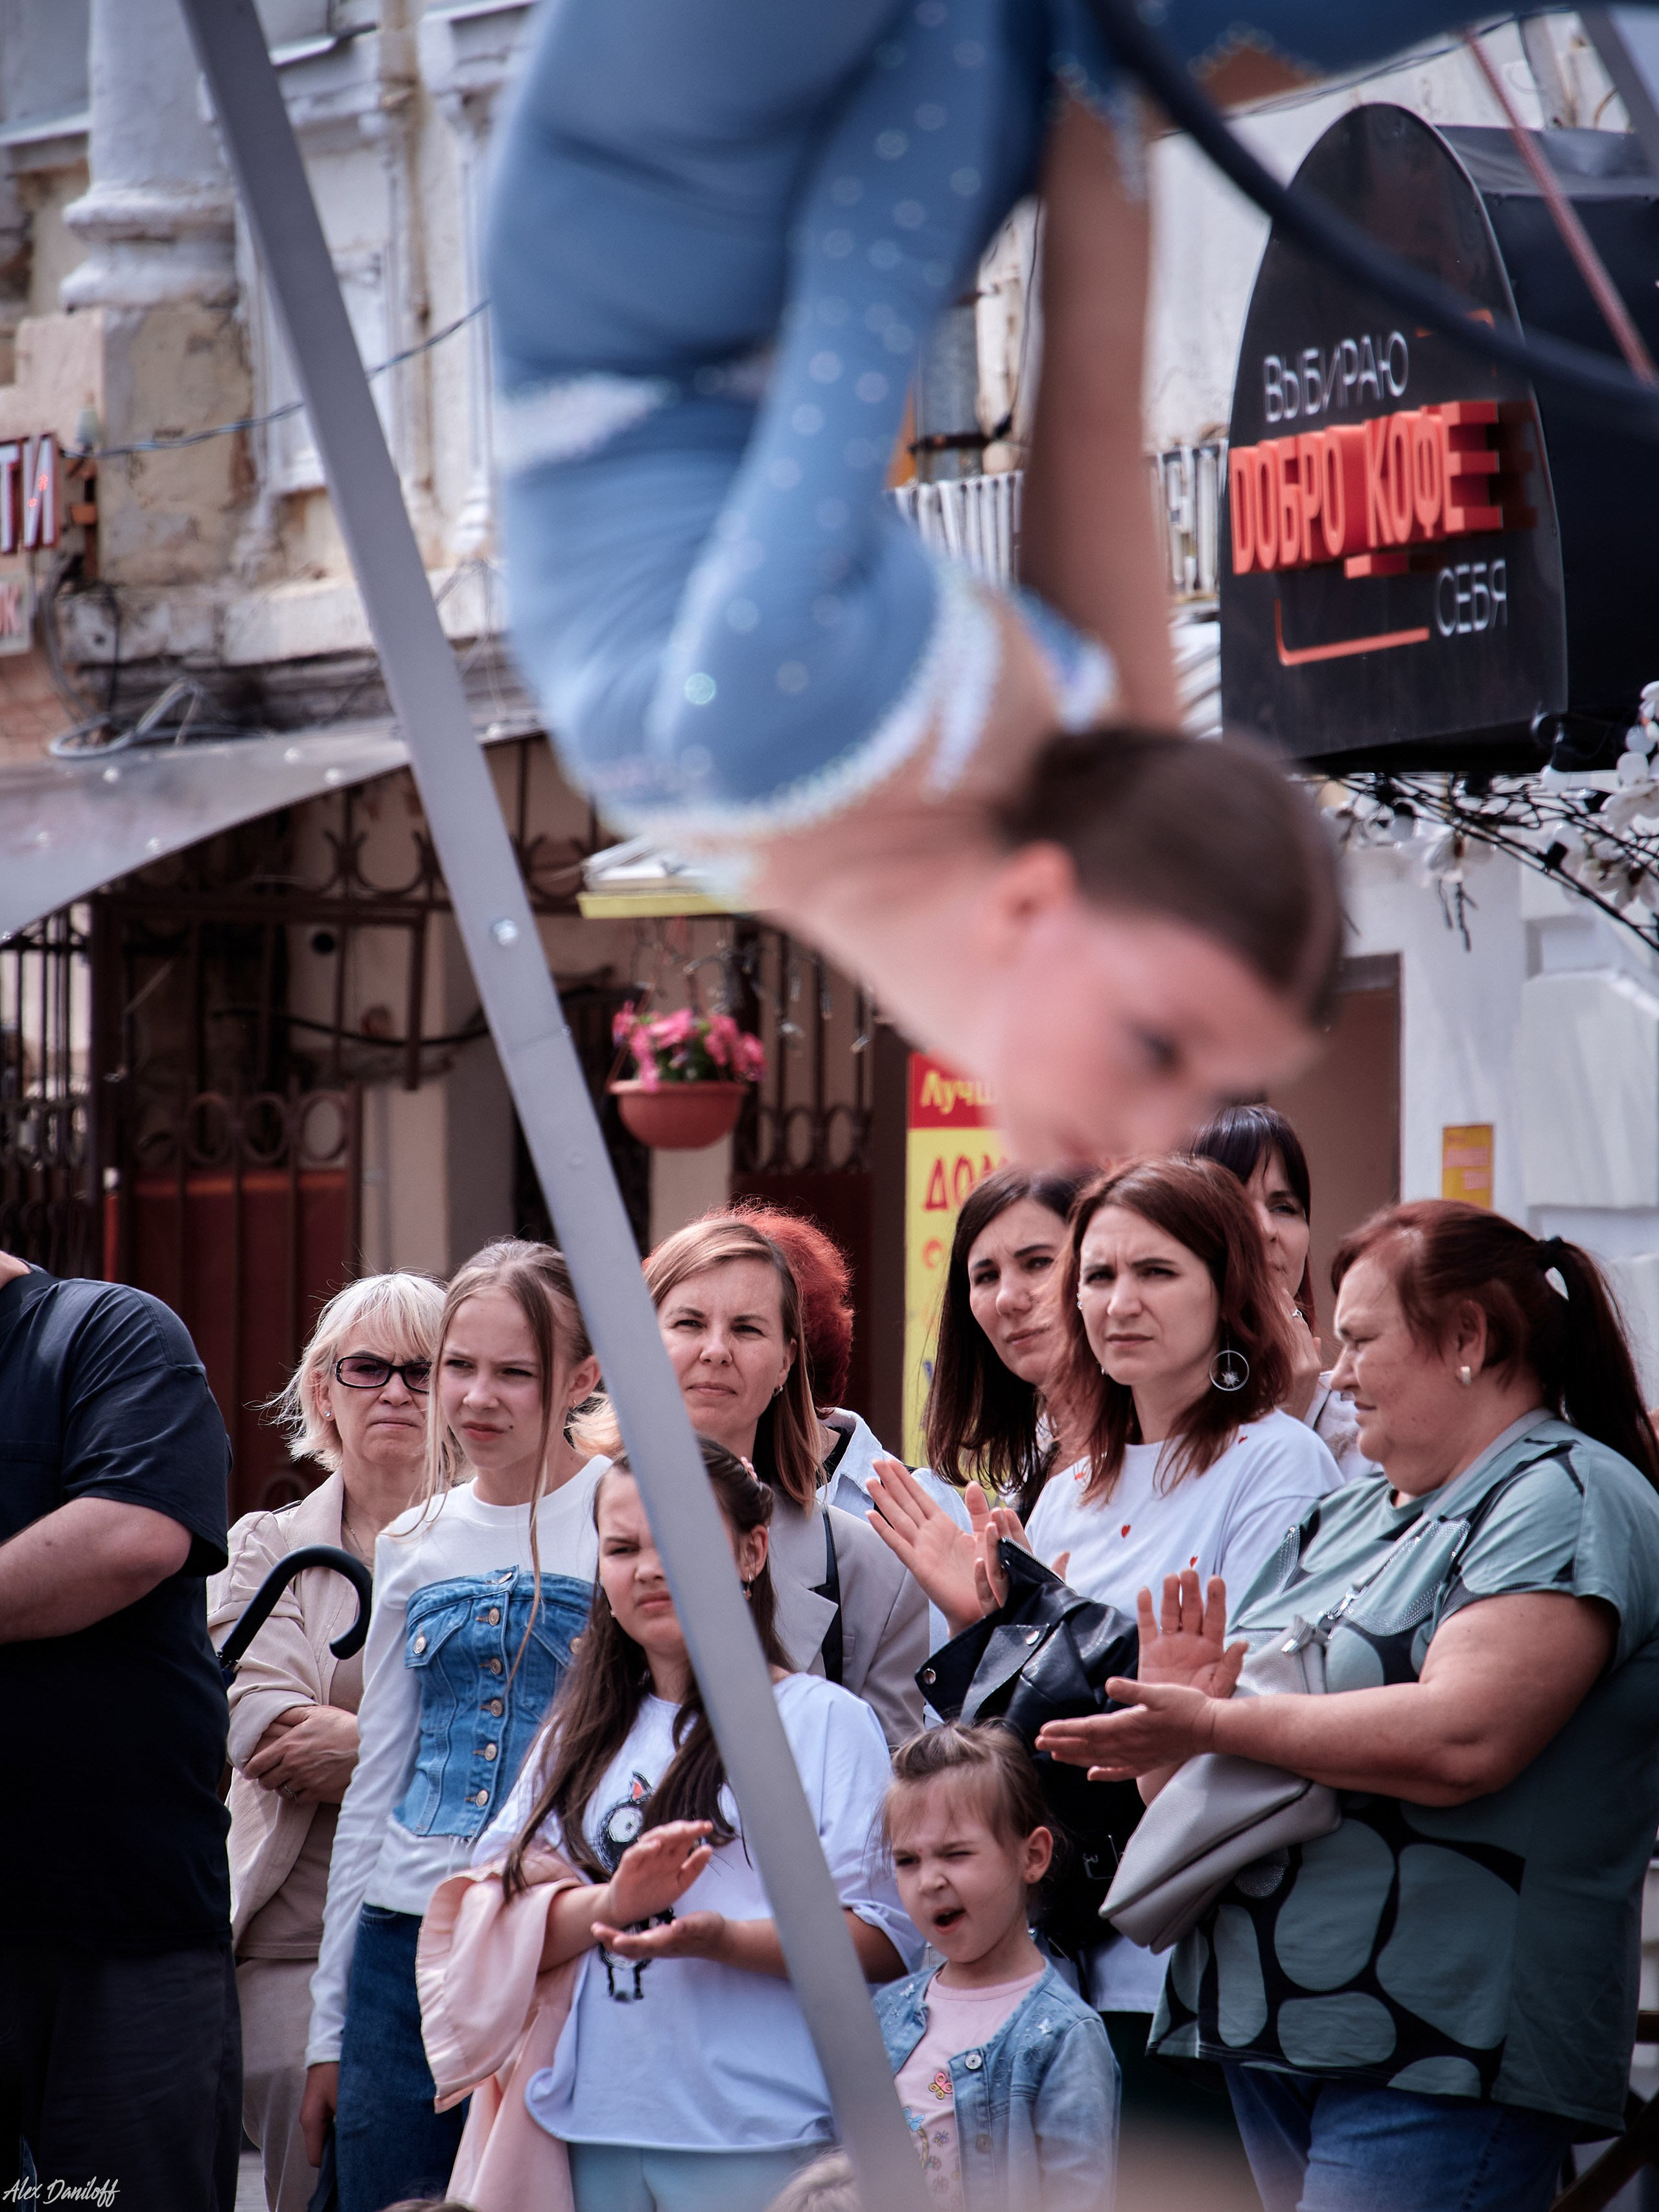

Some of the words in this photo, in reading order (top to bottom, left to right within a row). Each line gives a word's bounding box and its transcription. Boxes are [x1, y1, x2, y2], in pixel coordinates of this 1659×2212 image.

[1263, 331, 1408, 421] ВЫБИРАЮ
[1362, 401, 1497, 547] КОФЕ
[1437, 560, 1507, 636] СЕБЯ
